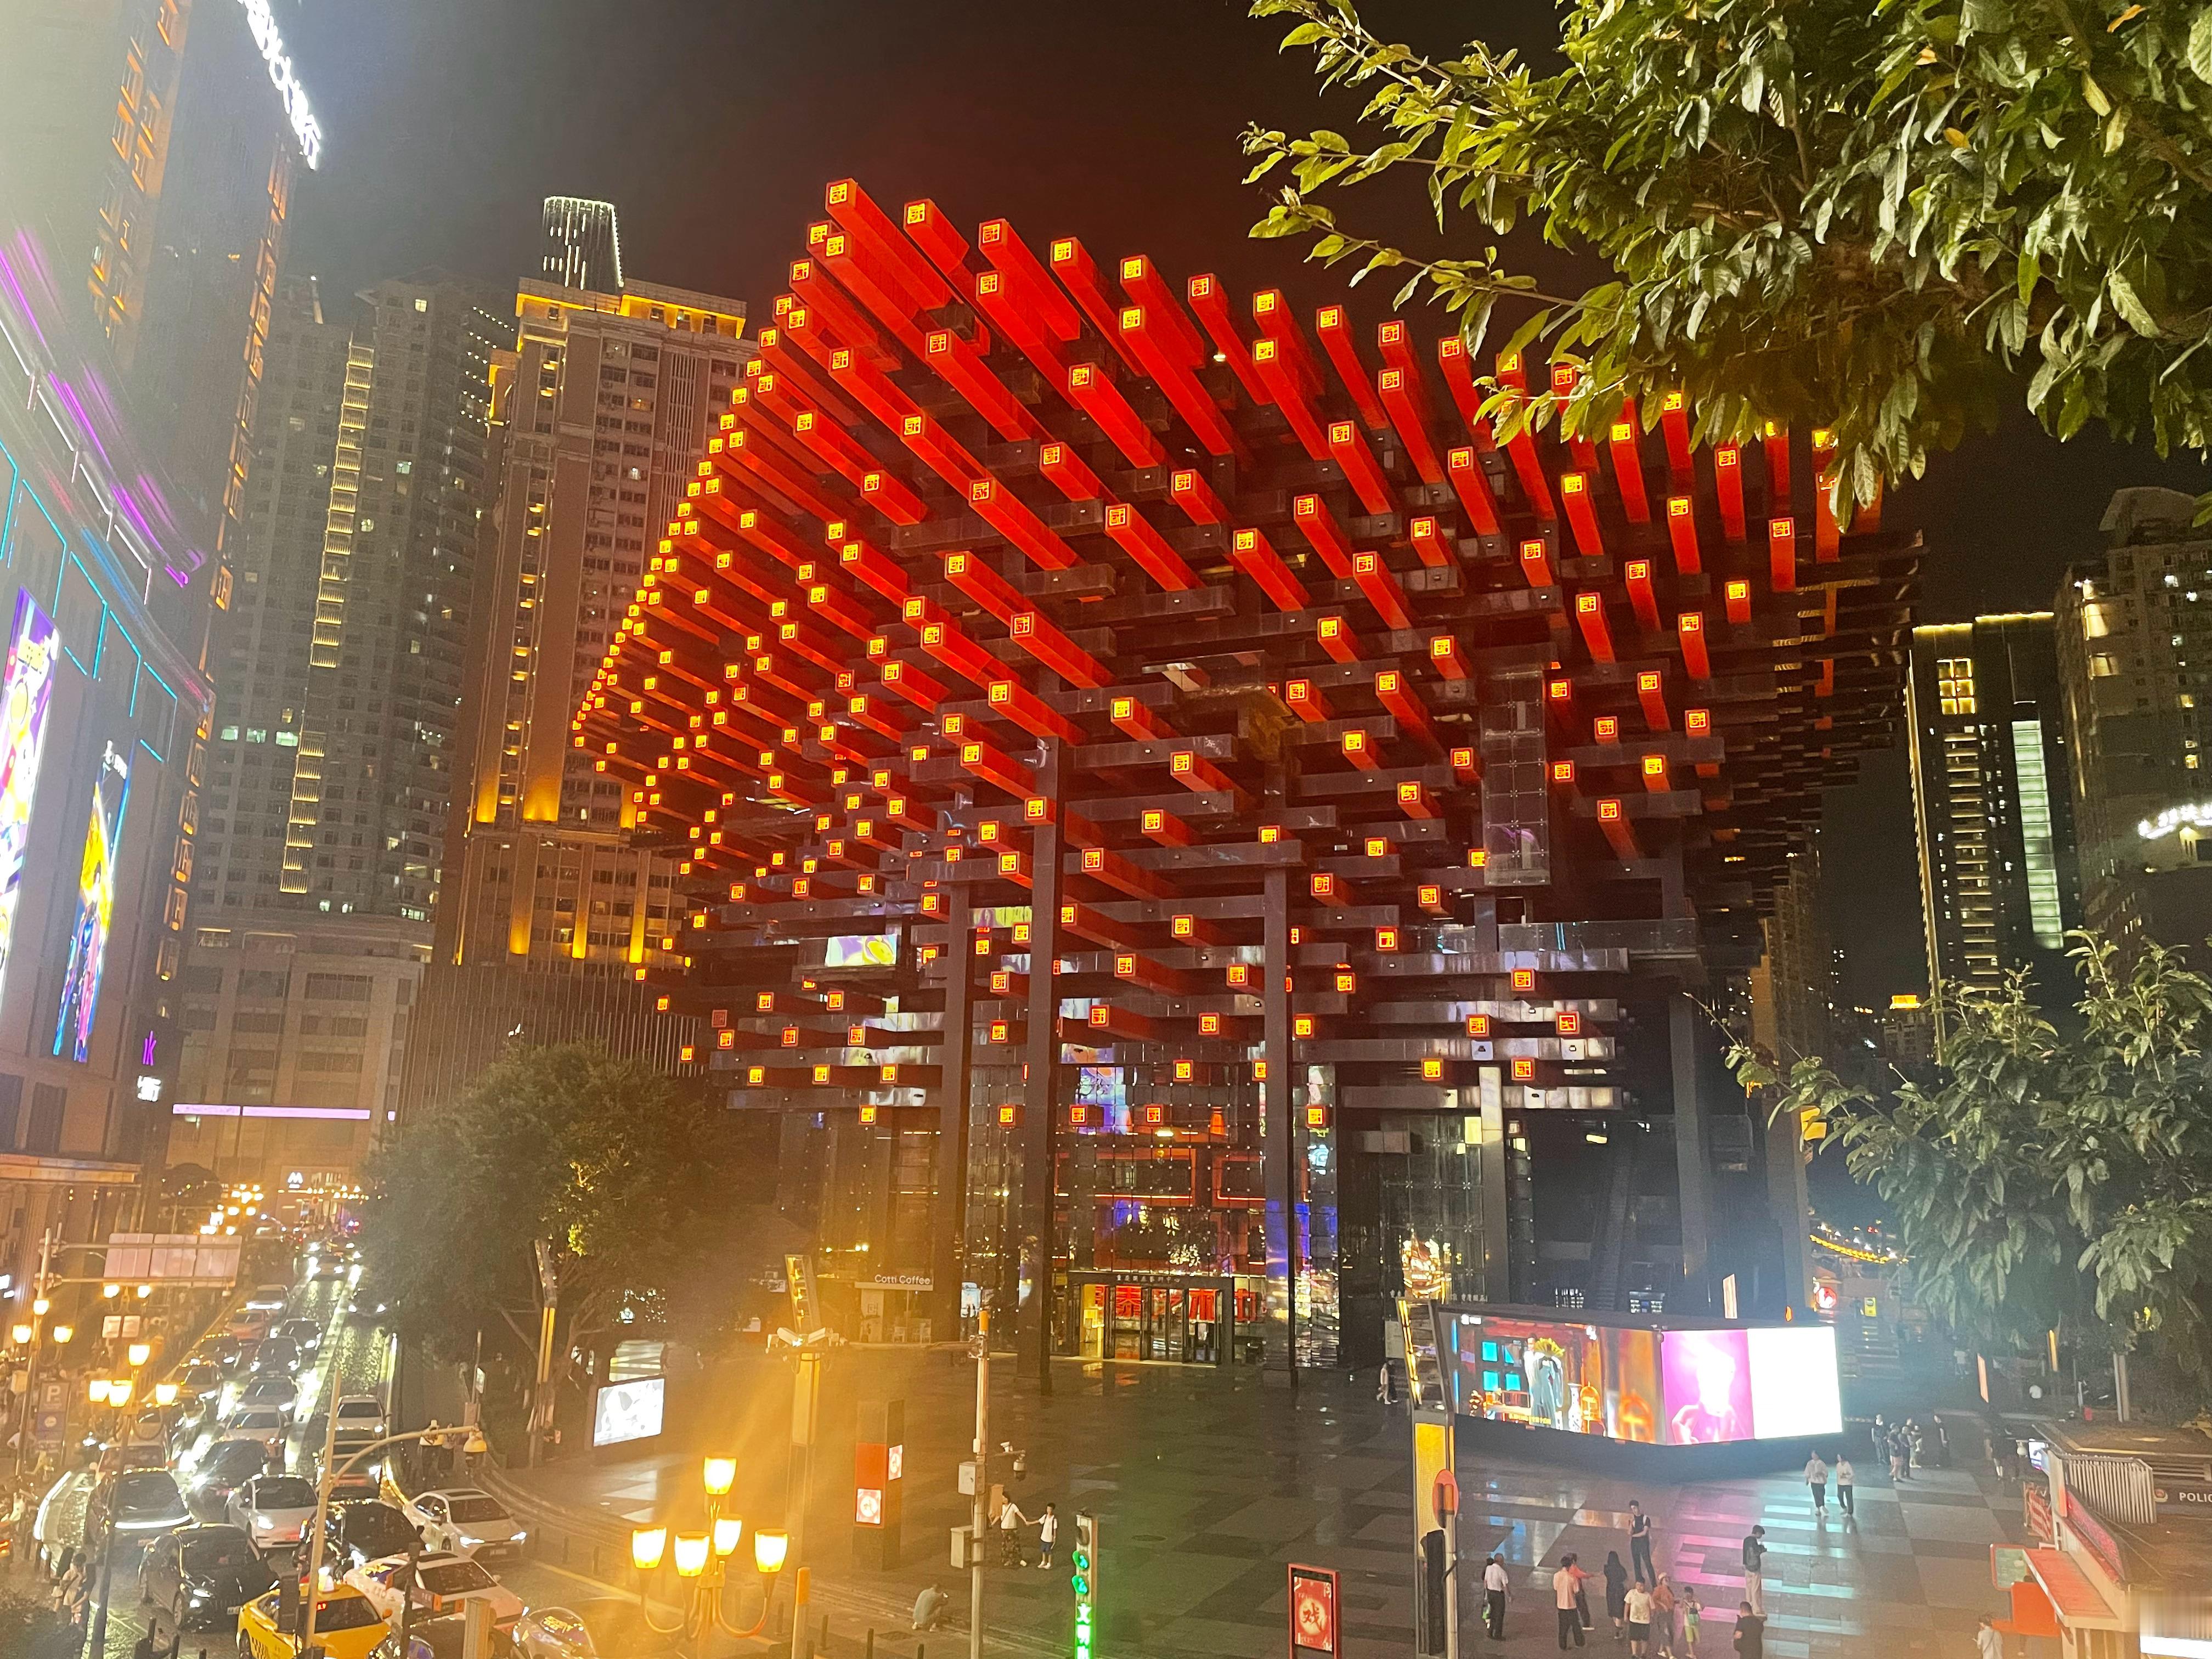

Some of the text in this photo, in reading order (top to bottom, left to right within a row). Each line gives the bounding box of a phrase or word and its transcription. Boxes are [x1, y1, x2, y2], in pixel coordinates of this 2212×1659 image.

[874, 1274, 930, 1285] Cotti Coffee
[47, 1385, 61, 1402] P
